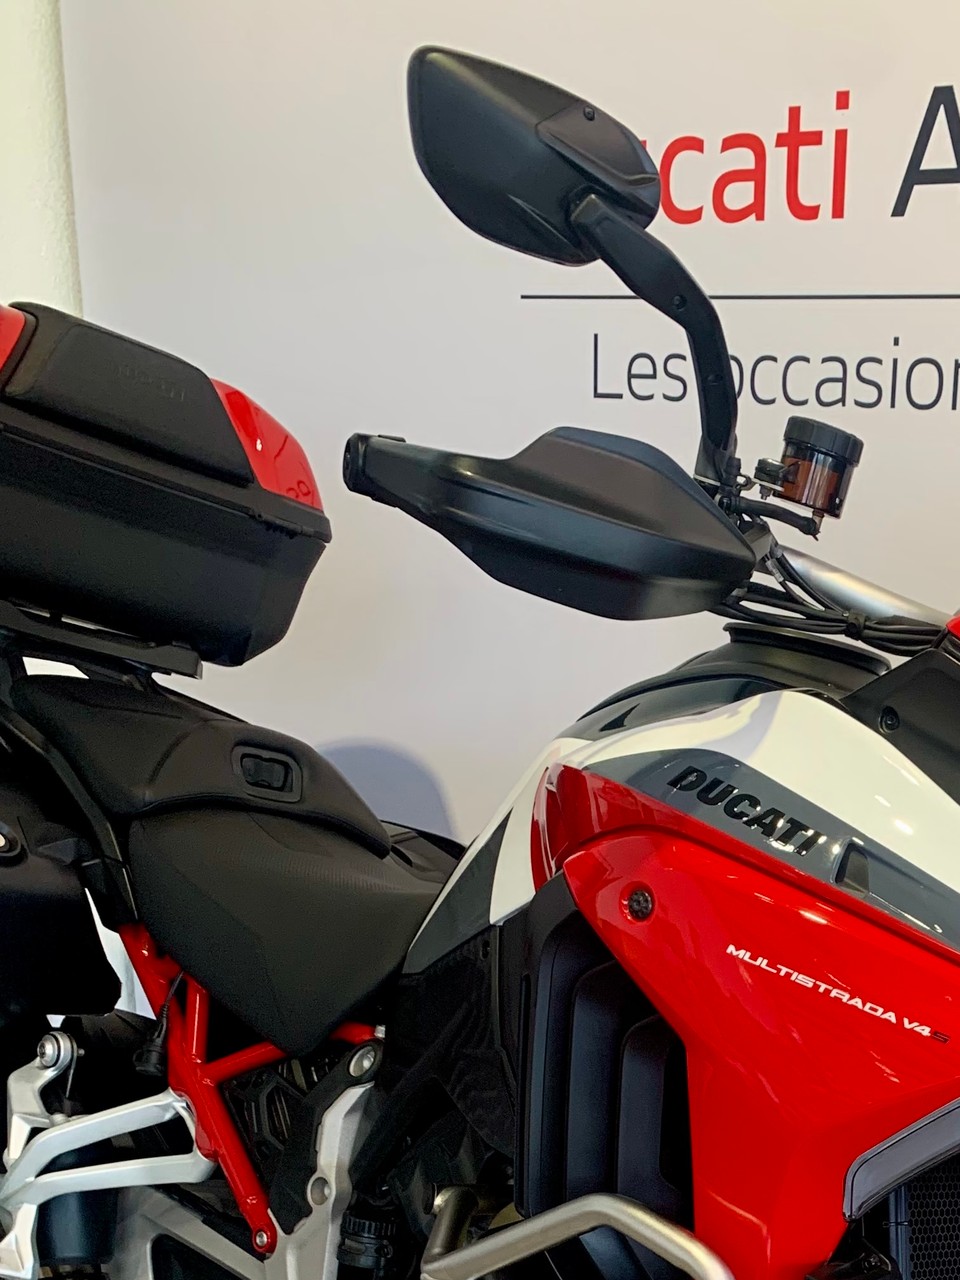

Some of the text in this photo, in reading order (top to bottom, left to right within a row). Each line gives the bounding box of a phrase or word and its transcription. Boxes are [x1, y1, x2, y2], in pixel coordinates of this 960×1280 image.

[643, 90, 850, 225] cati
[592, 333, 688, 402] Les
[667, 766, 827, 857] DUCATI
[726, 944, 897, 1024] MULTISTRADA
